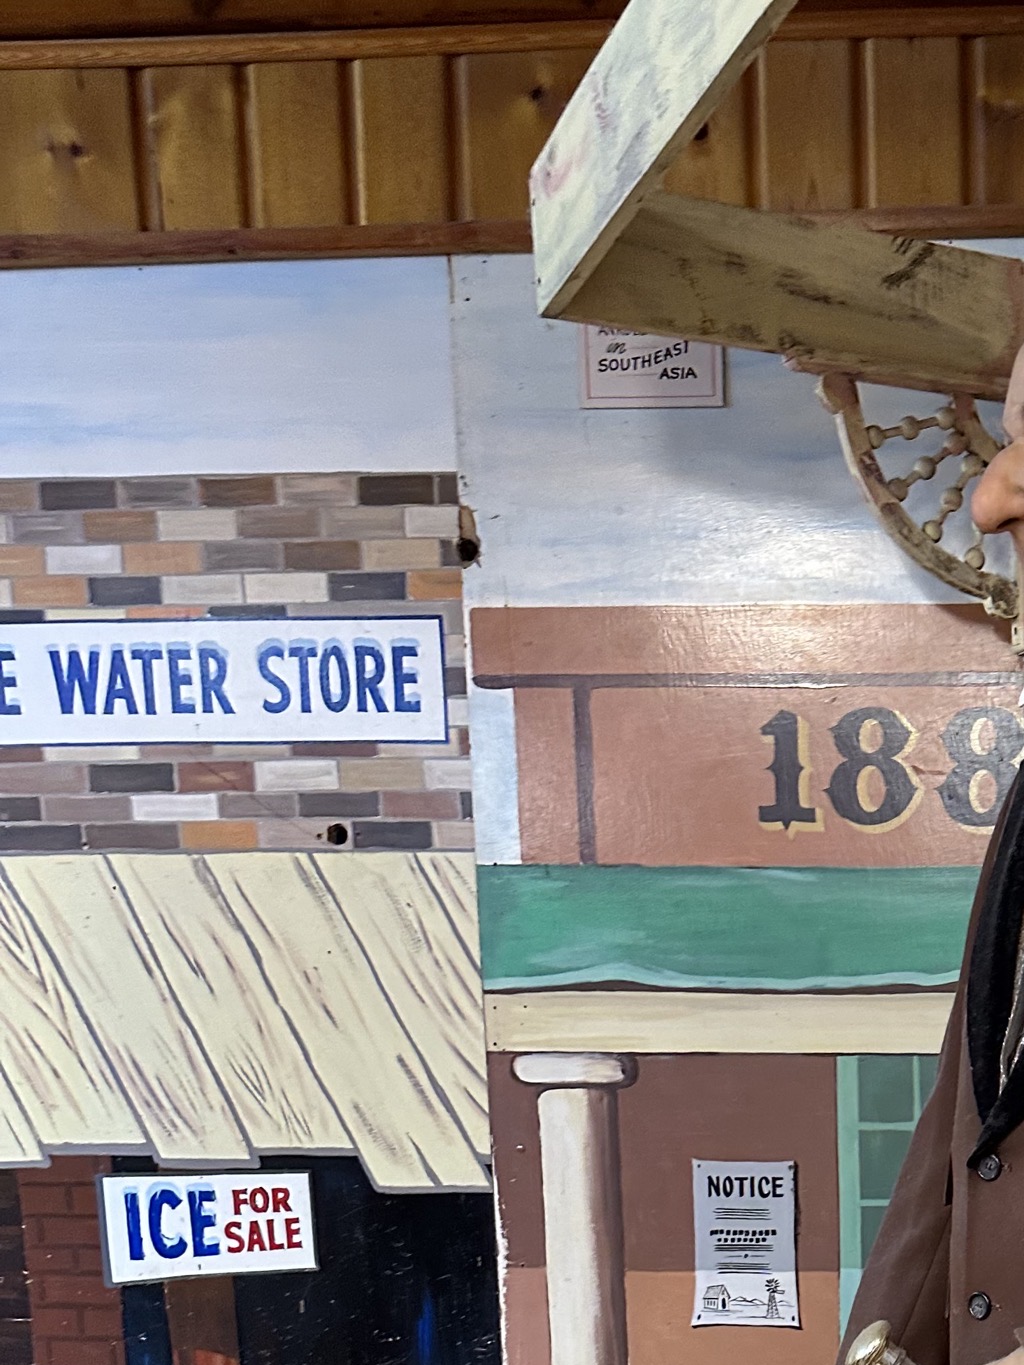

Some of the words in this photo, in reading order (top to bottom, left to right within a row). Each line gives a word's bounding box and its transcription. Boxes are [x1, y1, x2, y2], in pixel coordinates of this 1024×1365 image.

[598, 340, 689, 372] SOUTHEAST
[659, 366, 698, 380] ASIA
[48, 642, 236, 715] WATER
[258, 640, 421, 714] STORE
[232, 1187, 292, 1215] FOR
[707, 1175, 784, 1198] NOTICE
[123, 1182, 220, 1261] ICE
[224, 1217, 303, 1254] SALE
